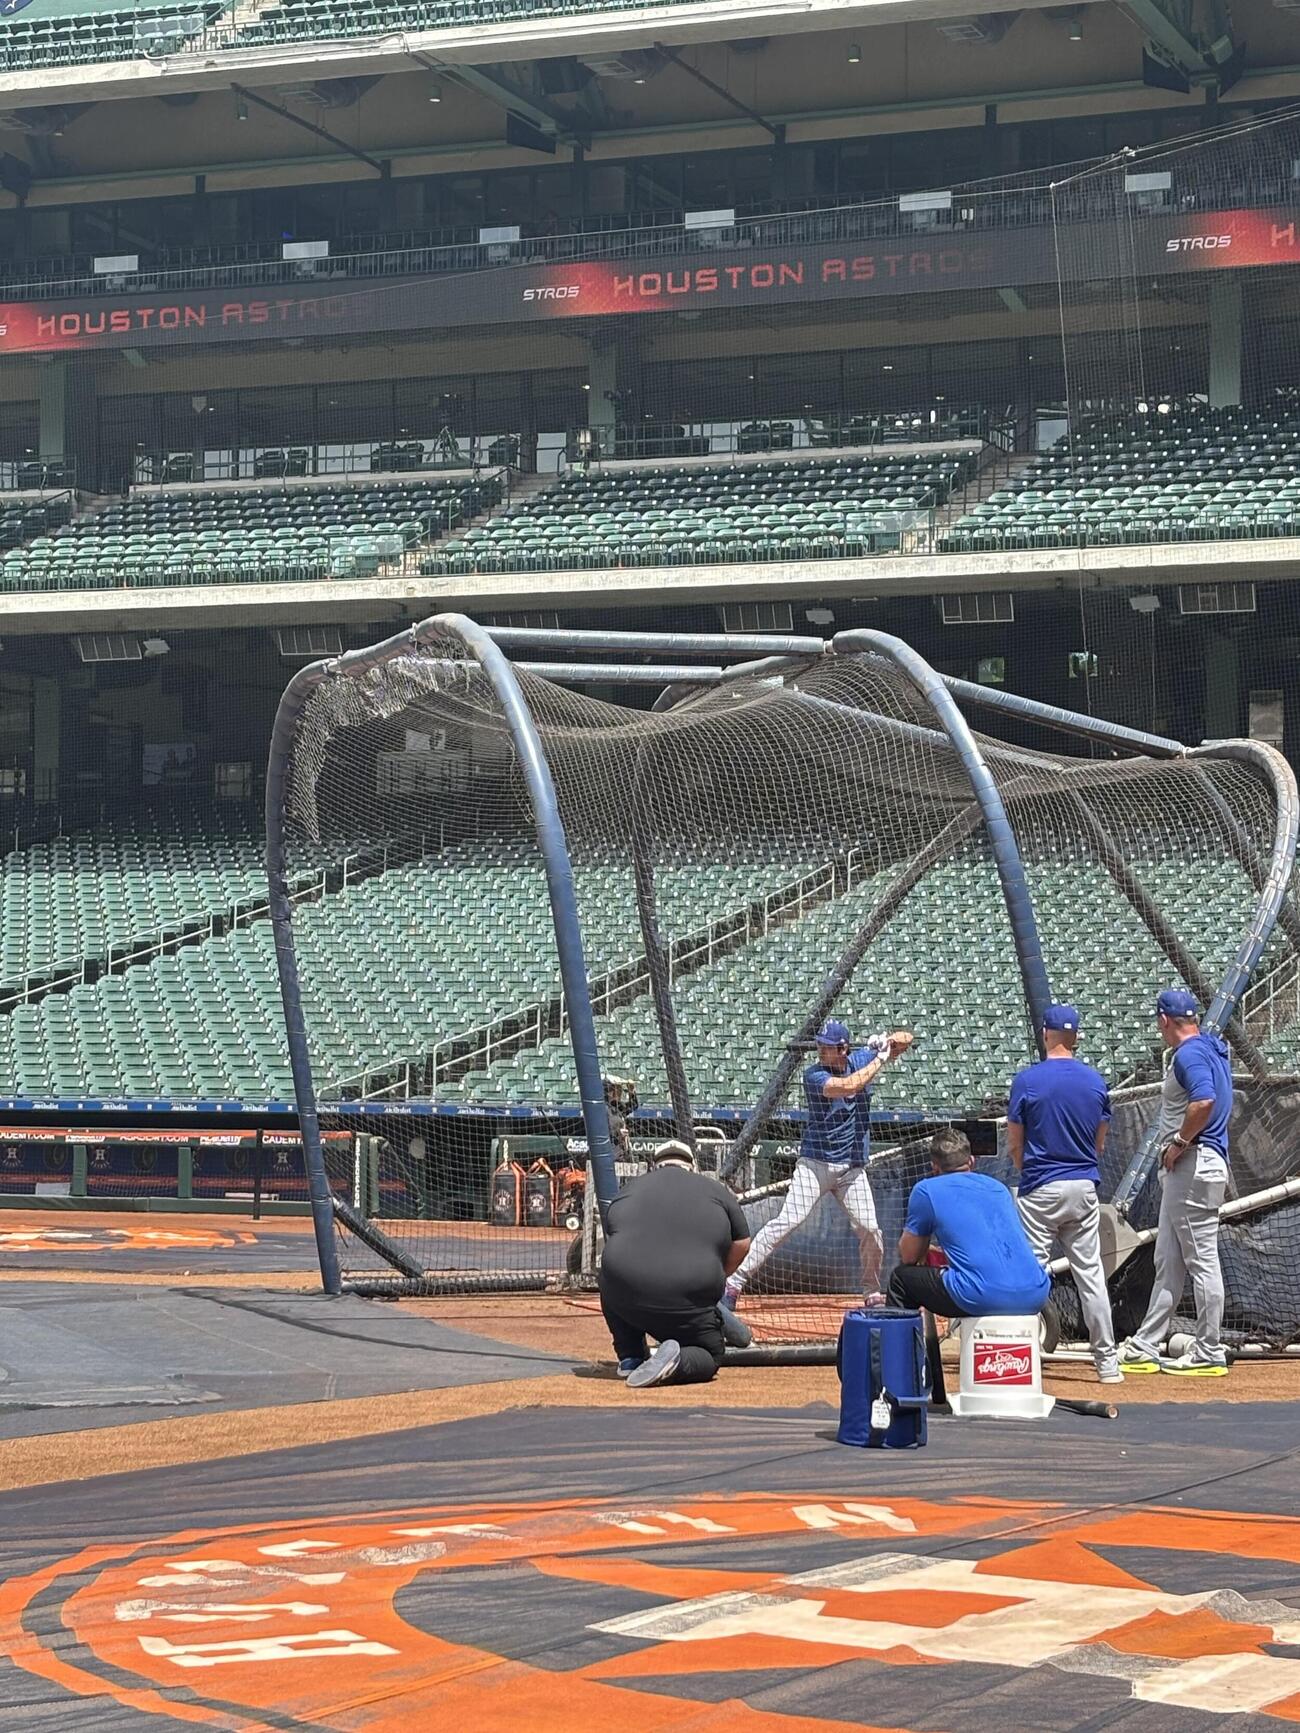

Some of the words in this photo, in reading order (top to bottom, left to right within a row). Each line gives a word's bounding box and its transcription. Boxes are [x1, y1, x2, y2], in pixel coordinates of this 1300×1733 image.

[1165, 234, 1232, 252] STROS
[613, 261, 804, 298] HOUSTON
[522, 285, 580, 301] STROS
[37, 304, 206, 337] HOUSTON
[977, 1352, 1030, 1376] Rawlings
